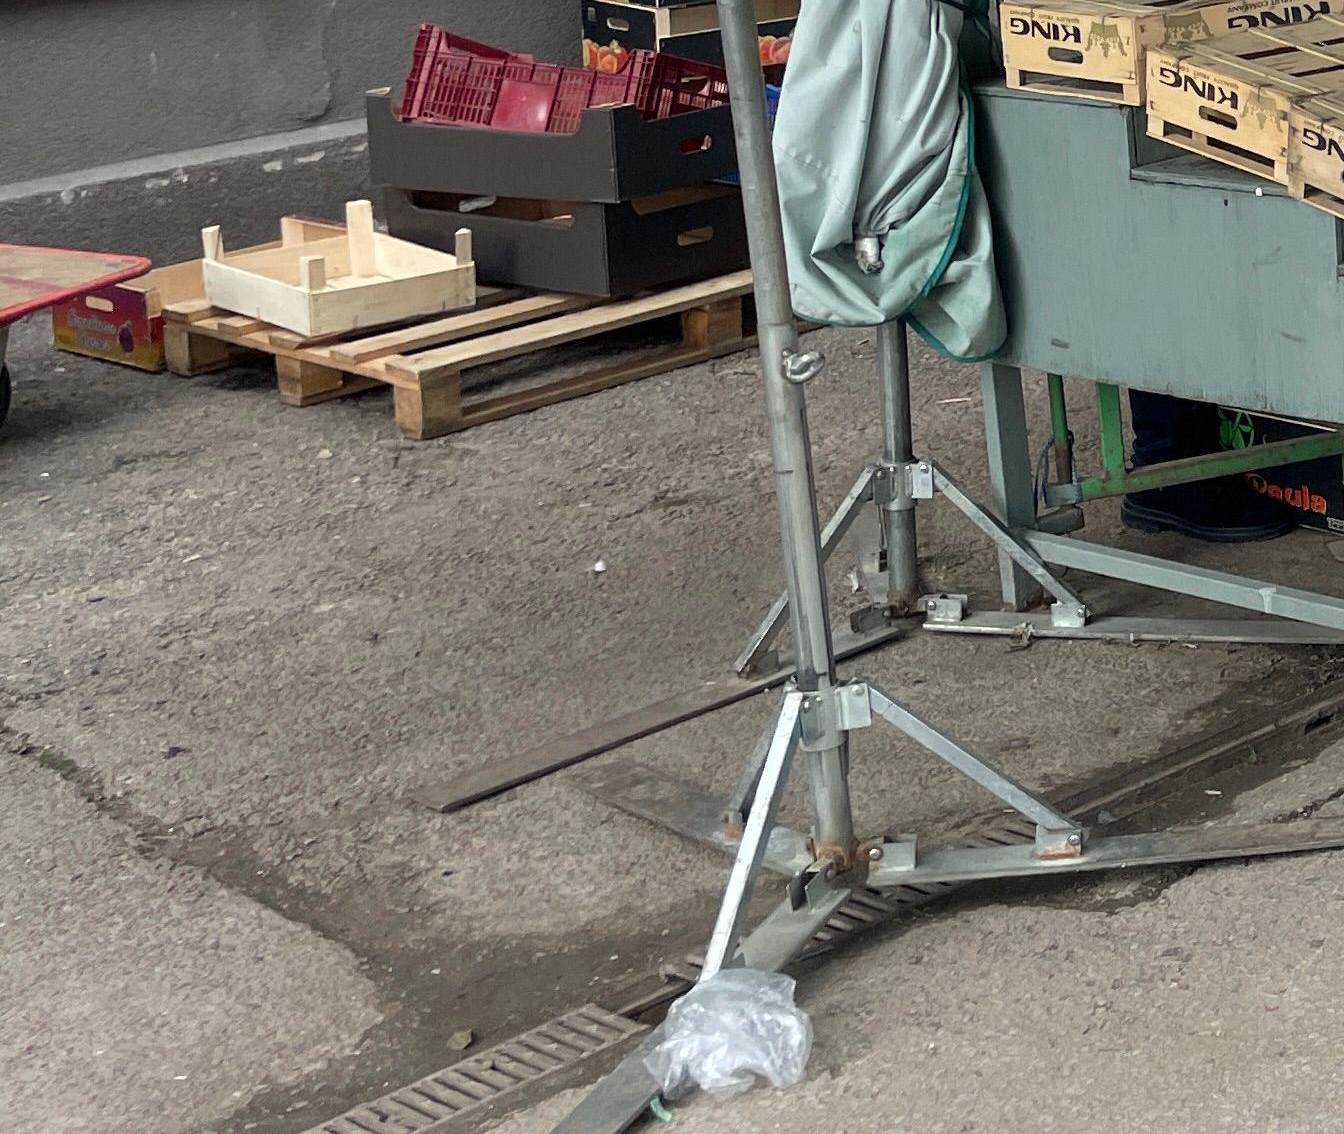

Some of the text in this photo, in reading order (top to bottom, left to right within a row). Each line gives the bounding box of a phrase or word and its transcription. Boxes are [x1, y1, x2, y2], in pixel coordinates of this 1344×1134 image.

[1228, 1, 1330, 29] KING
[1010, 17, 1081, 43] KING
[1159, 67, 1238, 109] KING
